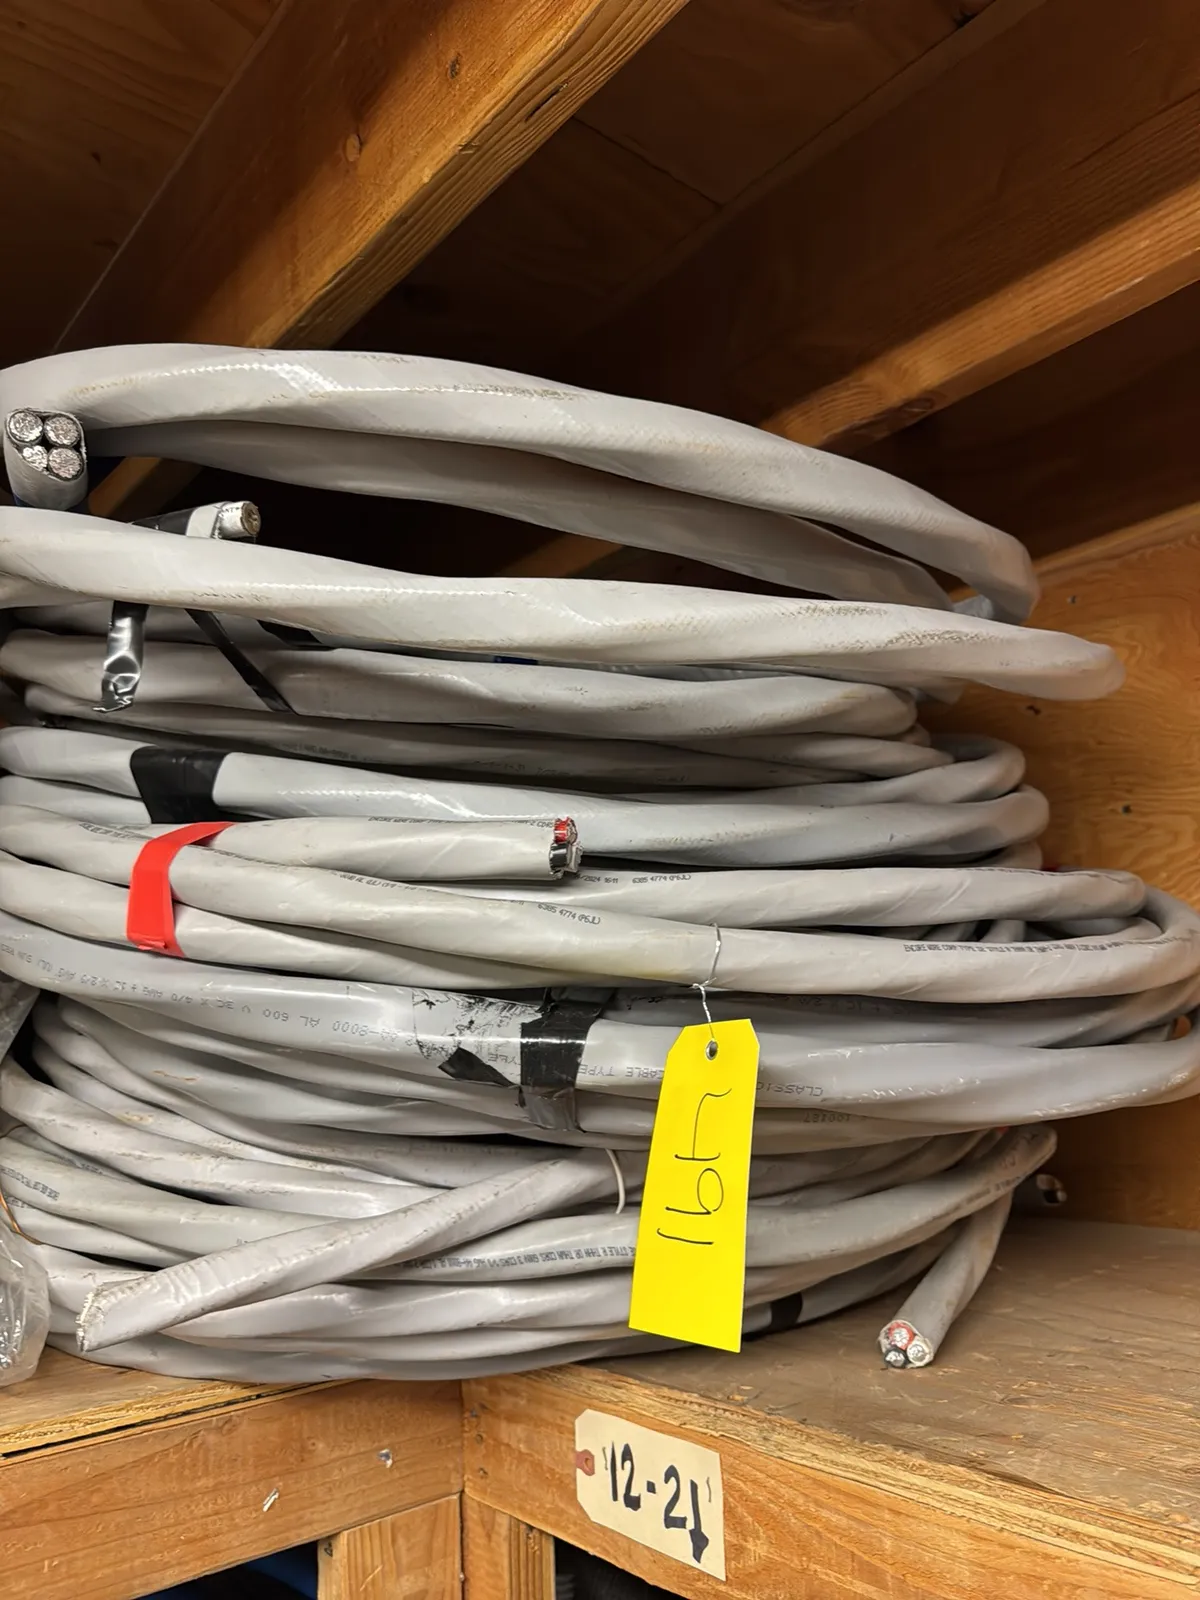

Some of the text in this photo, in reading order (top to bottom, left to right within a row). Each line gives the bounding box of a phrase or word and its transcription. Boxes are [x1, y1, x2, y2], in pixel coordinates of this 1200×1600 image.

[262, 1008, 290, 1022] 600
[299, 1015, 321, 1028] AL
[579, 1063, 614, 1077] TYPE
